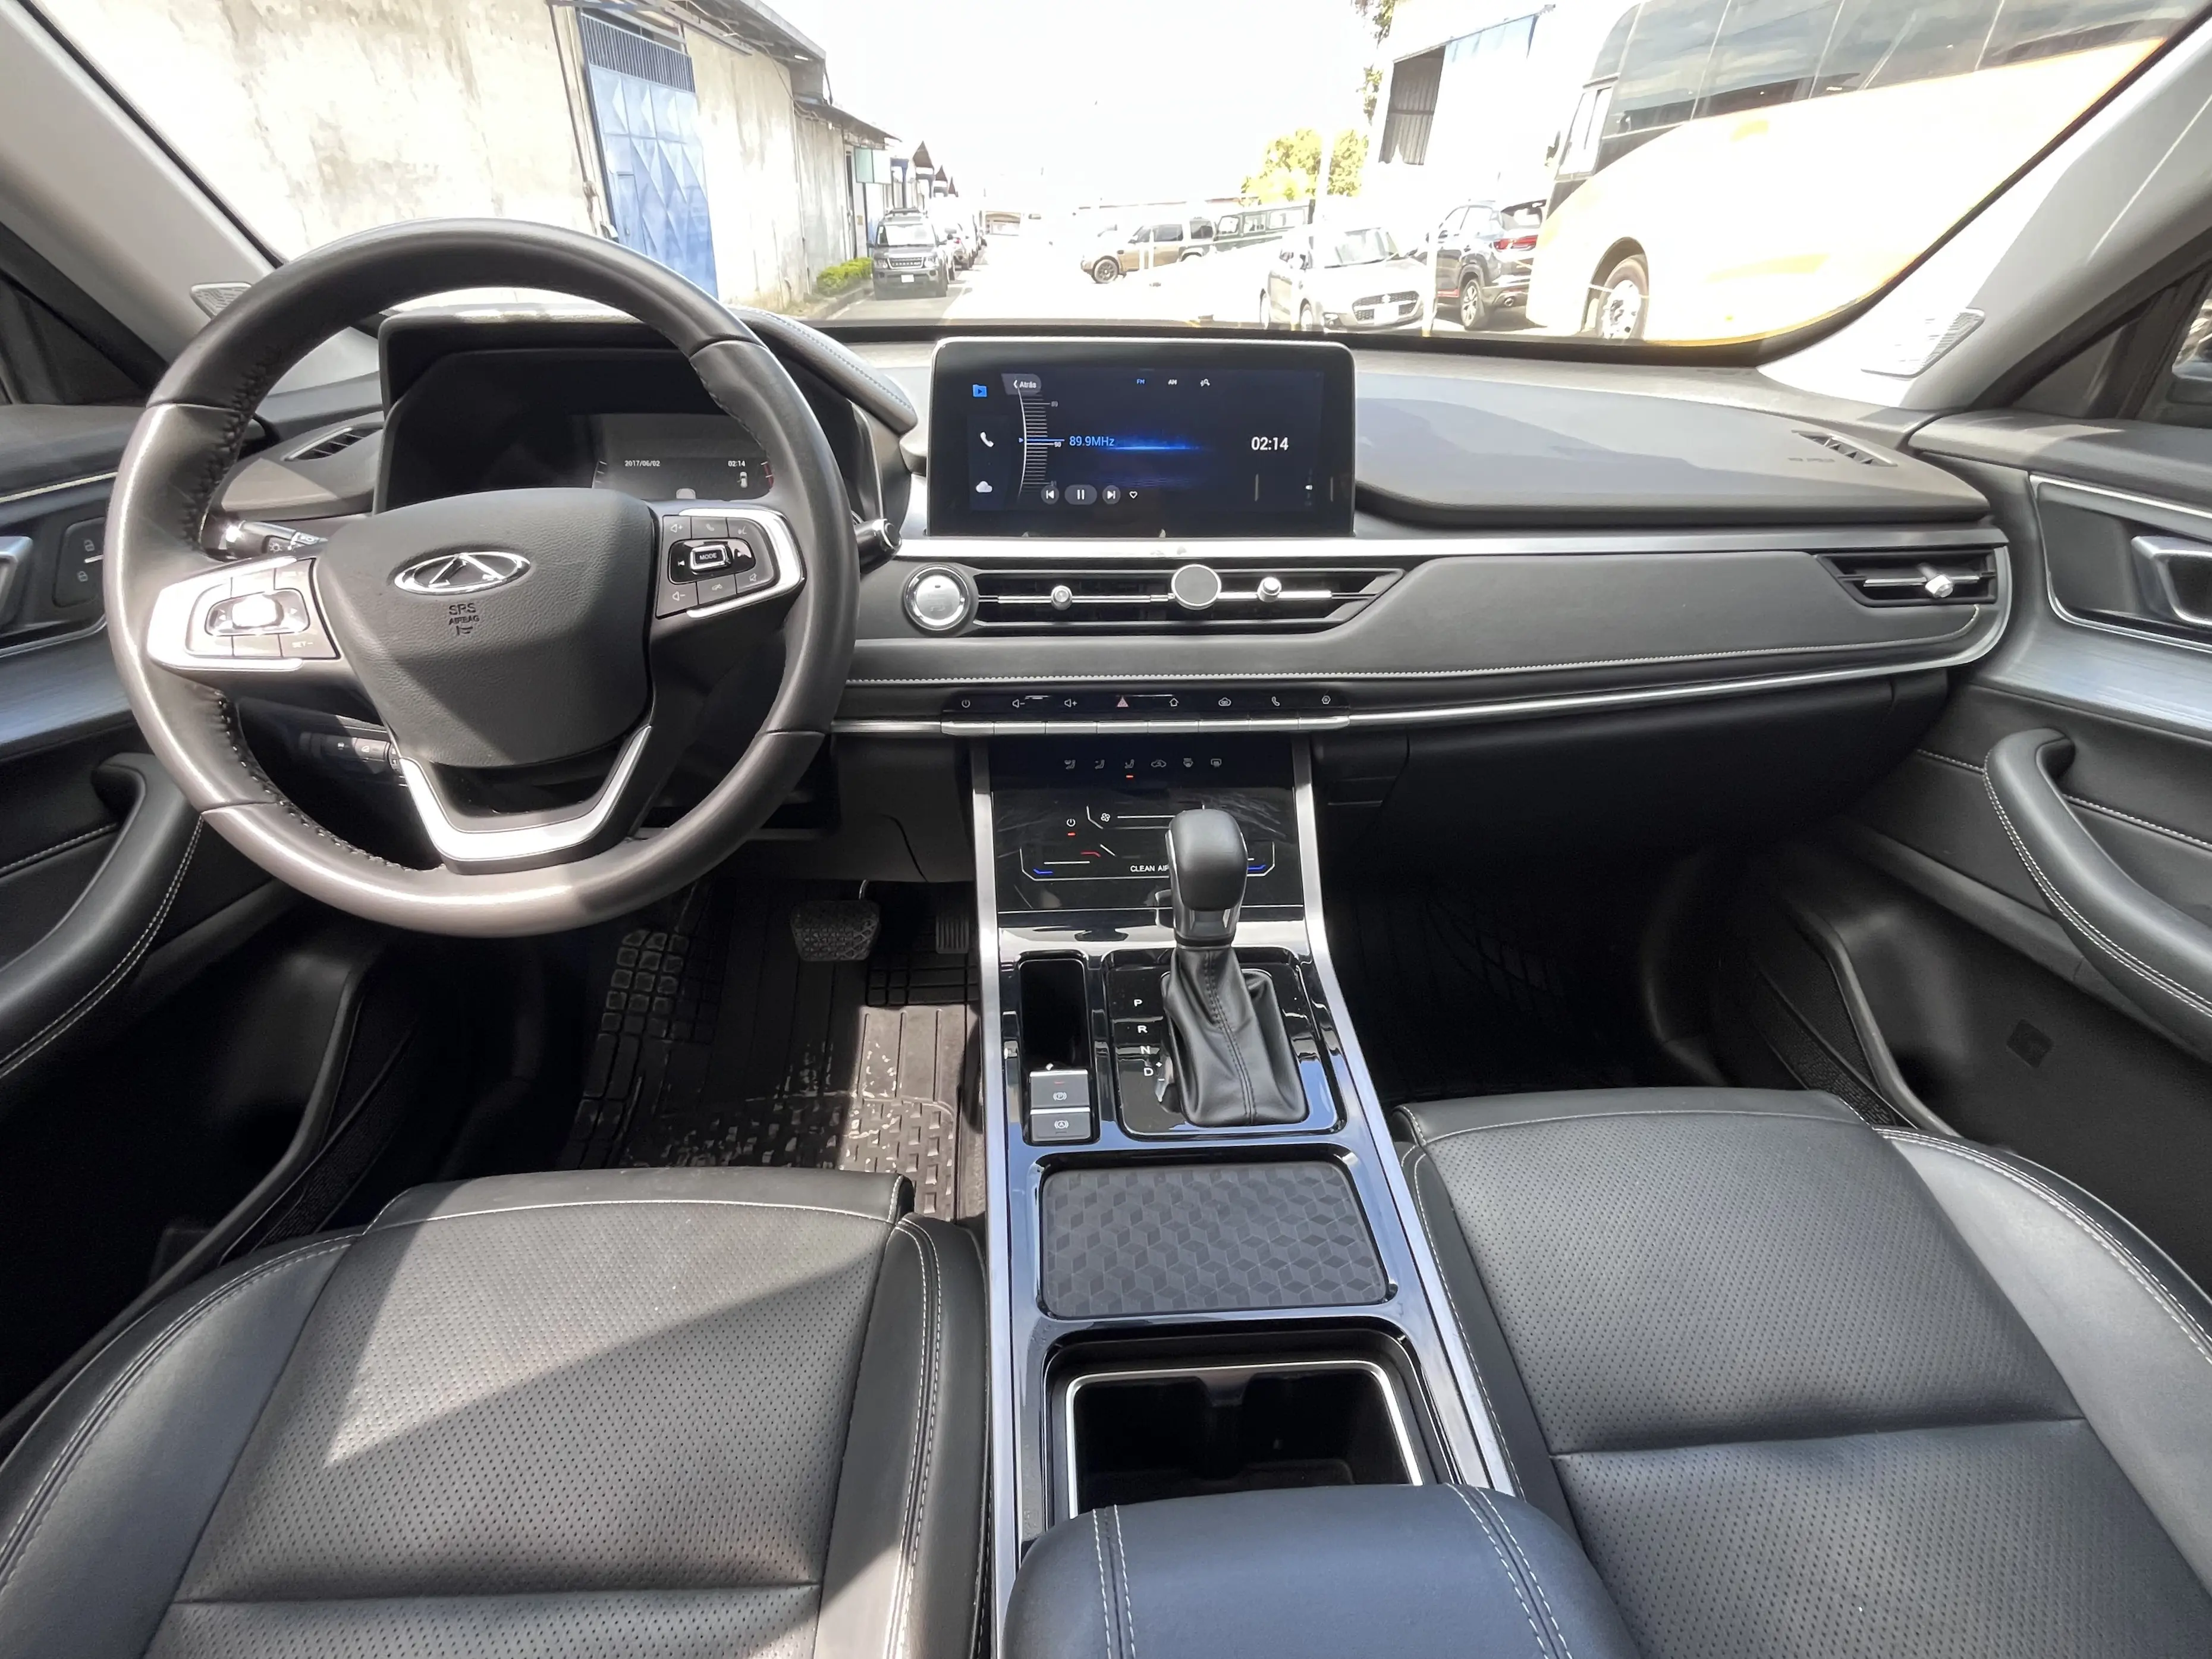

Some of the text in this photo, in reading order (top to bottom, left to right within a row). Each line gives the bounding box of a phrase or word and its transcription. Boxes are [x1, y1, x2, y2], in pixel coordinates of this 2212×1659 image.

[1069, 435, 1116, 447] 89.9MHz
[1250, 436, 1289, 451] 02:14
[1137, 1025, 1148, 1033] R
[1140, 1045, 1151, 1054] N
[1143, 1067, 1154, 1076] D
